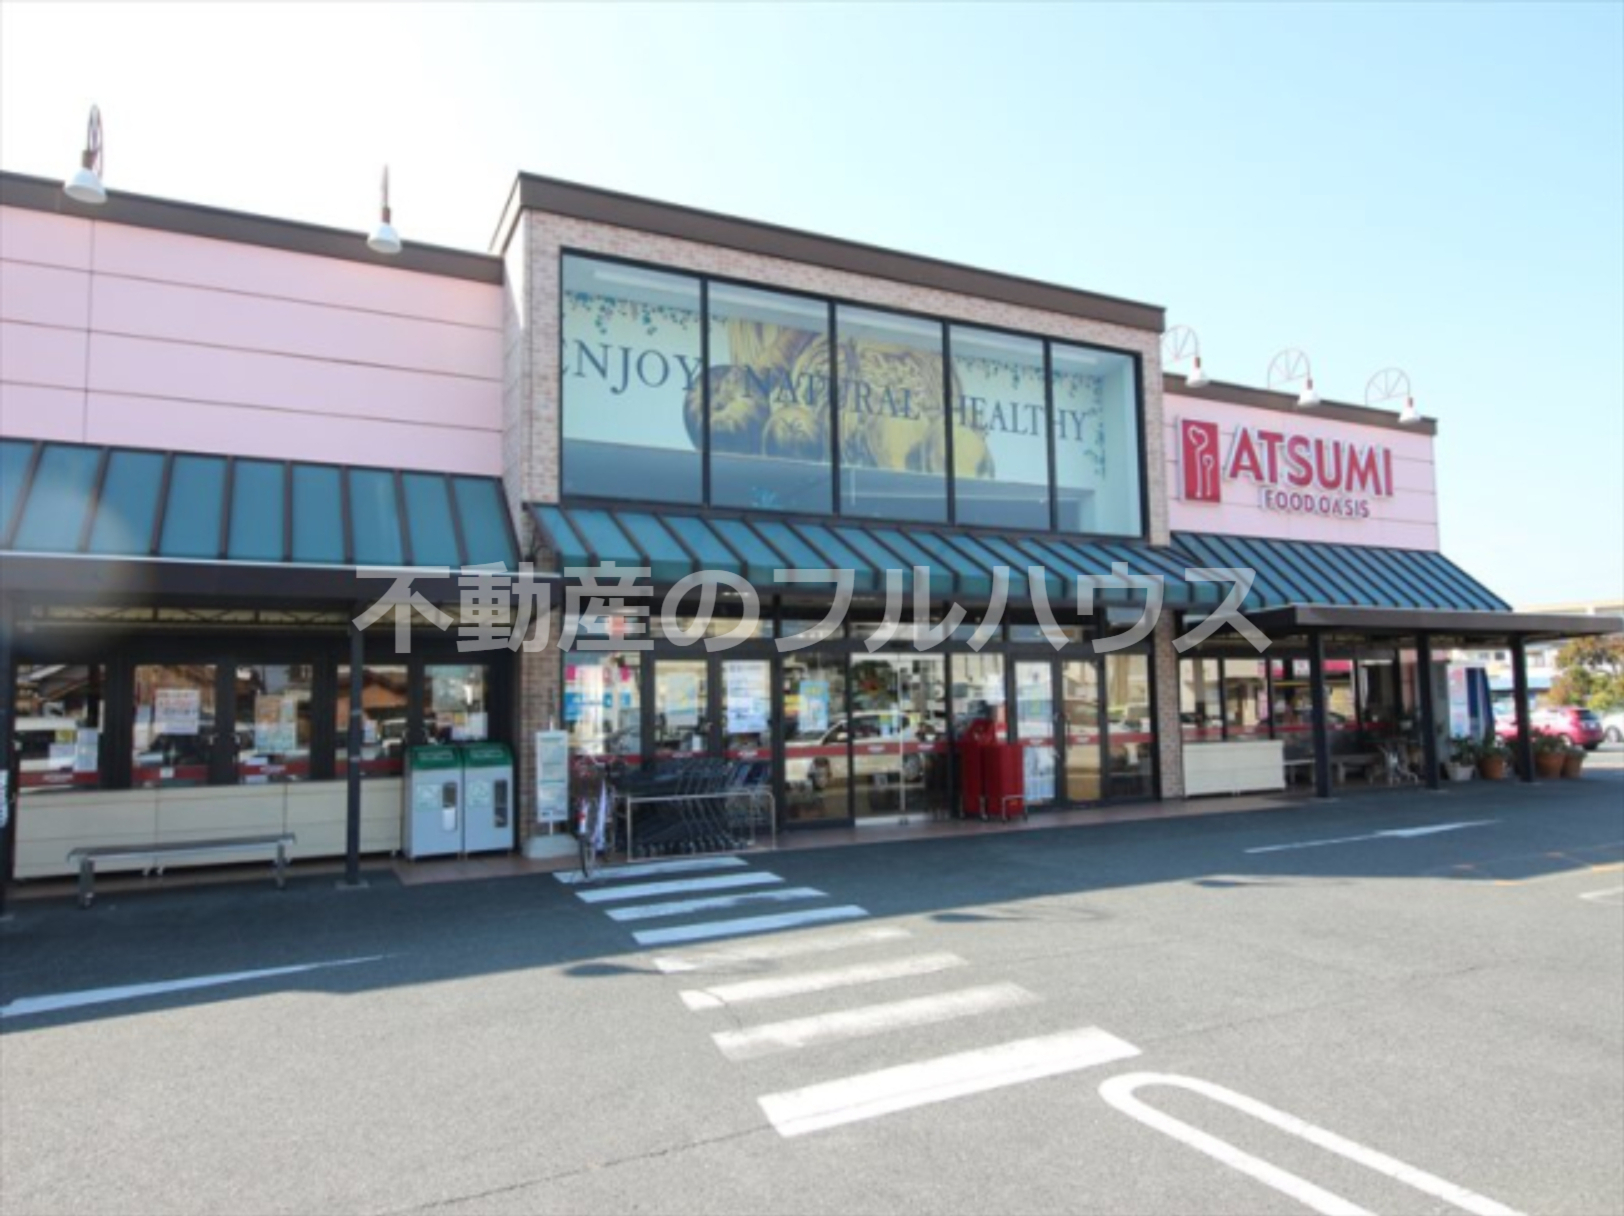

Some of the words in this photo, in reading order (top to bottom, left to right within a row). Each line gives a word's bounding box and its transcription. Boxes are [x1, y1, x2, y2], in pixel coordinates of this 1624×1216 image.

[562, 338, 703, 395] NJOY
[1229, 427, 1393, 496] ATSUMI
[1264, 489, 1315, 513] FOOD
[1319, 495, 1370, 518] OASIS
